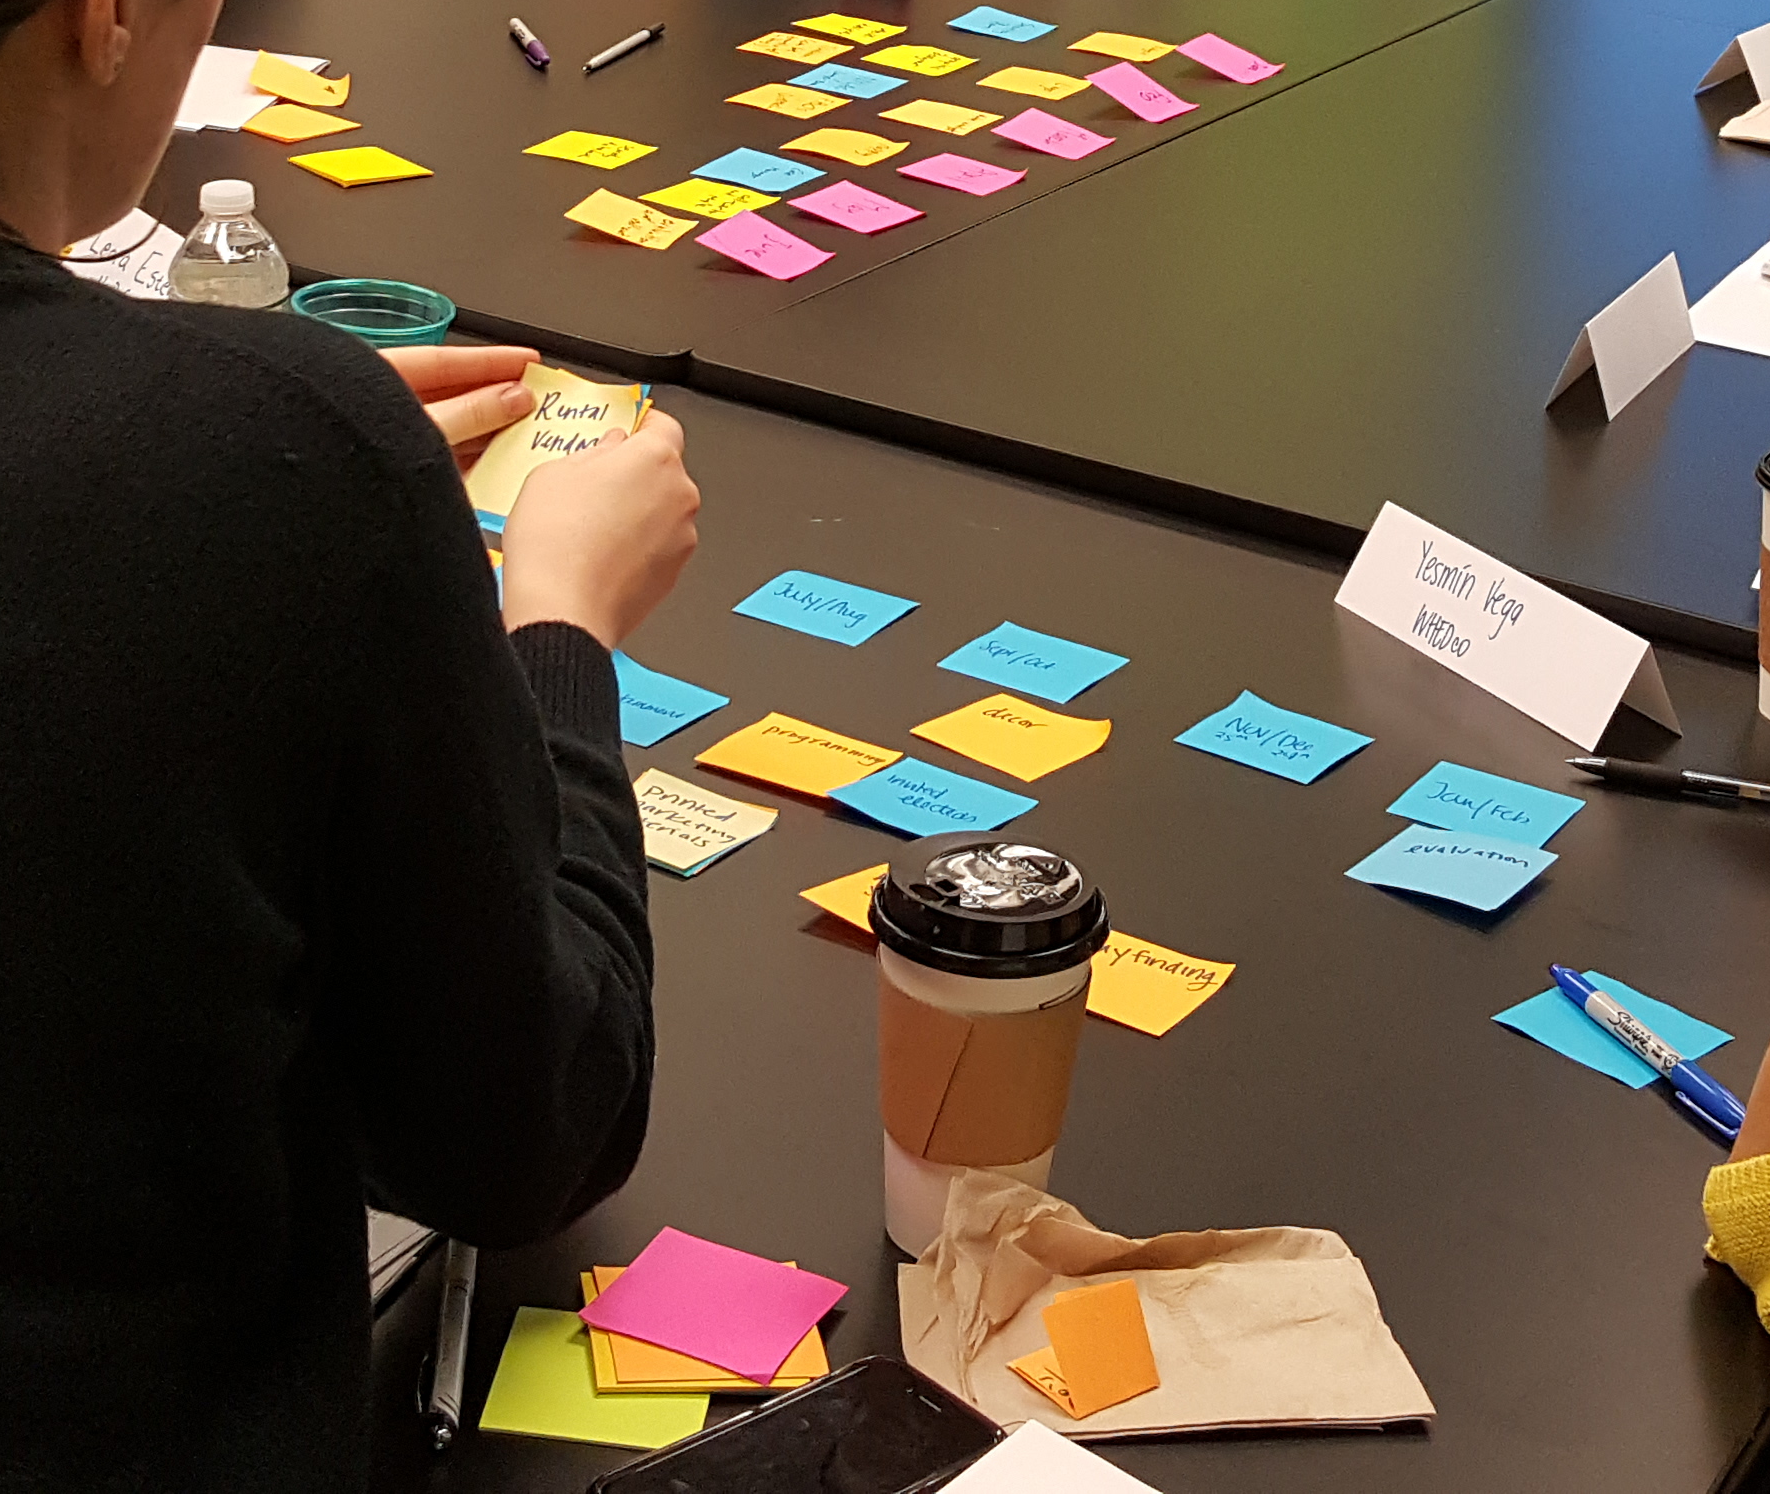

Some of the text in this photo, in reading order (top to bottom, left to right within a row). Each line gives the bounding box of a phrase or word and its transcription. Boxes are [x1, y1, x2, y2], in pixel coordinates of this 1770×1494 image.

[134, 251, 171, 296] Este
[534, 392, 609, 421] Rental
[774, 582, 868, 629] July/Aug
[1483, 578, 1524, 640] Vega
[979, 640, 1057, 670] Sept/Oct
[982, 708, 1048, 729] decor
[1225, 717, 1314, 753] Nov/Dec
[762, 726, 886, 767] programming
[642, 785, 737, 823] printed
[1427, 781, 1531, 824] Jan/Feb
[1404, 845, 1529, 868] evaluation
[1607, 1011, 1649, 1053] Sharpie
